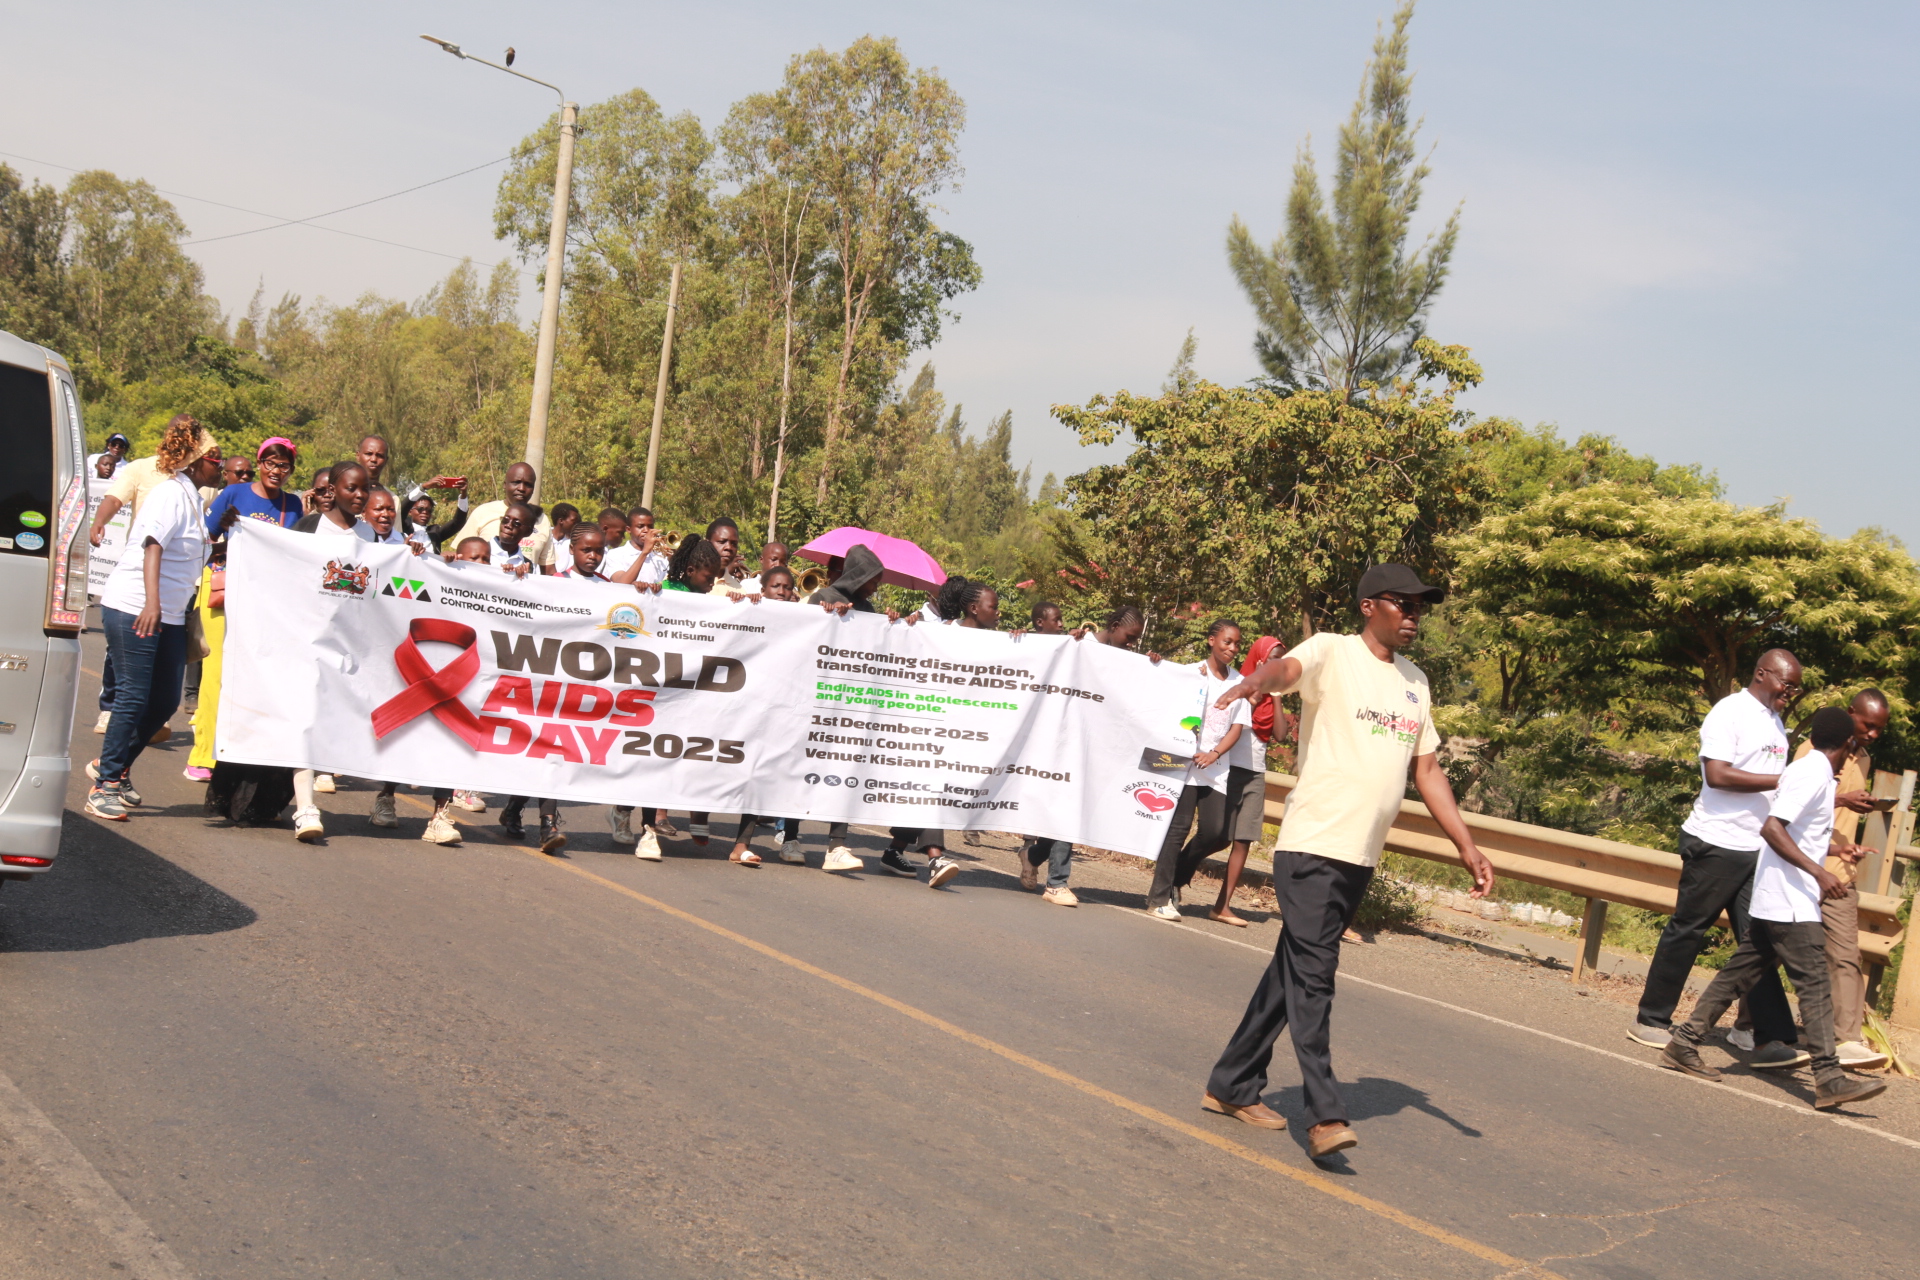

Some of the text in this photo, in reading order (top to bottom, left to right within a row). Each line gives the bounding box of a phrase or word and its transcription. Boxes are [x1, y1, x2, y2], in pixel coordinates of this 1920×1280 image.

[440, 586, 592, 616] NATIONAL SYNDEMIC DISEASES
[440, 597, 534, 620] CONTROL COUNCIL
[656, 630, 715, 642] of Kisumu
[658, 616, 697, 629] County
[699, 620, 766, 634] Government
[490, 630, 747, 693] WORLD
[816, 658, 928, 684] transforming
[931, 671, 967, 686] the
[968, 678, 1018, 691] AIDS
[817, 644, 1035, 681] Overcoming disruption,
[480, 674, 657, 728] AIDS
[815, 691, 947, 714] and young people.
[816, 681, 1019, 711] Ending AIDS in adolescents
[811, 714, 990, 742] 1st December 2025
[1356, 706, 1420, 734] WORLD AIDS
[1371, 724, 1388, 738] DAY
[475, 715, 622, 766] DAY
[622, 730, 746, 765] 2025
[808, 731, 945, 756] Kisumu County
[805, 747, 1071, 783] Venue: Kisian Primary School
[862, 792, 1020, 811] @KisumuCountyKE
[863, 778, 990, 798] @nsdcc_kenya
[1121, 781, 1151, 794] HEART
[1152, 781, 1166, 790] TO
[1134, 809, 1164, 822] SMILE
